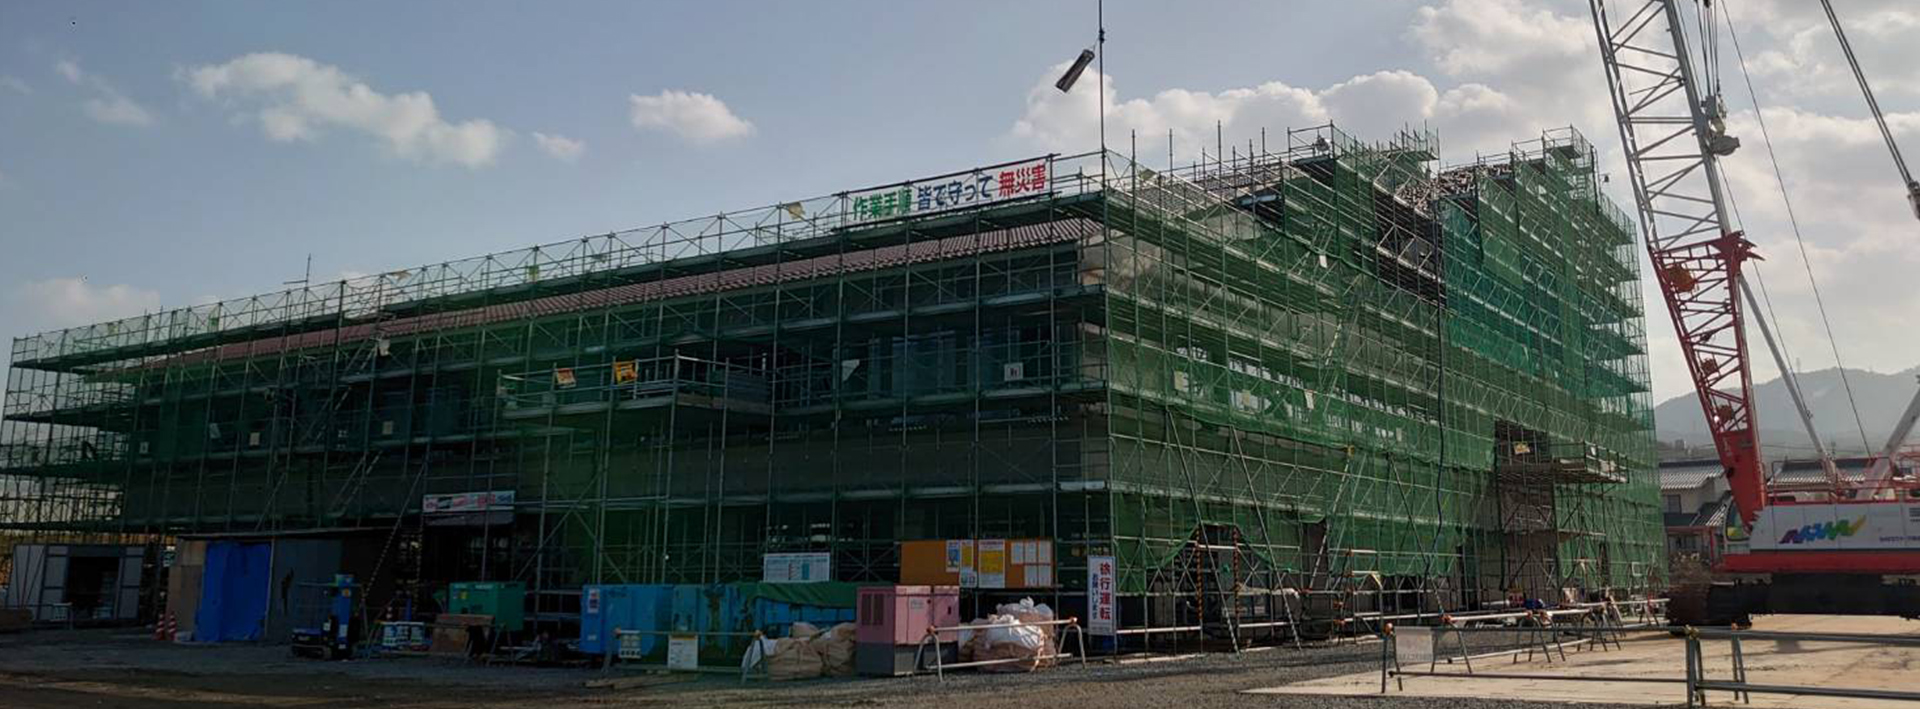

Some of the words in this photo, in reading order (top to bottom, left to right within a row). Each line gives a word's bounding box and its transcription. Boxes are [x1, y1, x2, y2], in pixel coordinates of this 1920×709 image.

[853, 188, 912, 220] 作業手順
[917, 175, 993, 210] 皆で守って
[998, 163, 1046, 197] 無災害
[1100, 562, 1111, 620] 徐行運転
